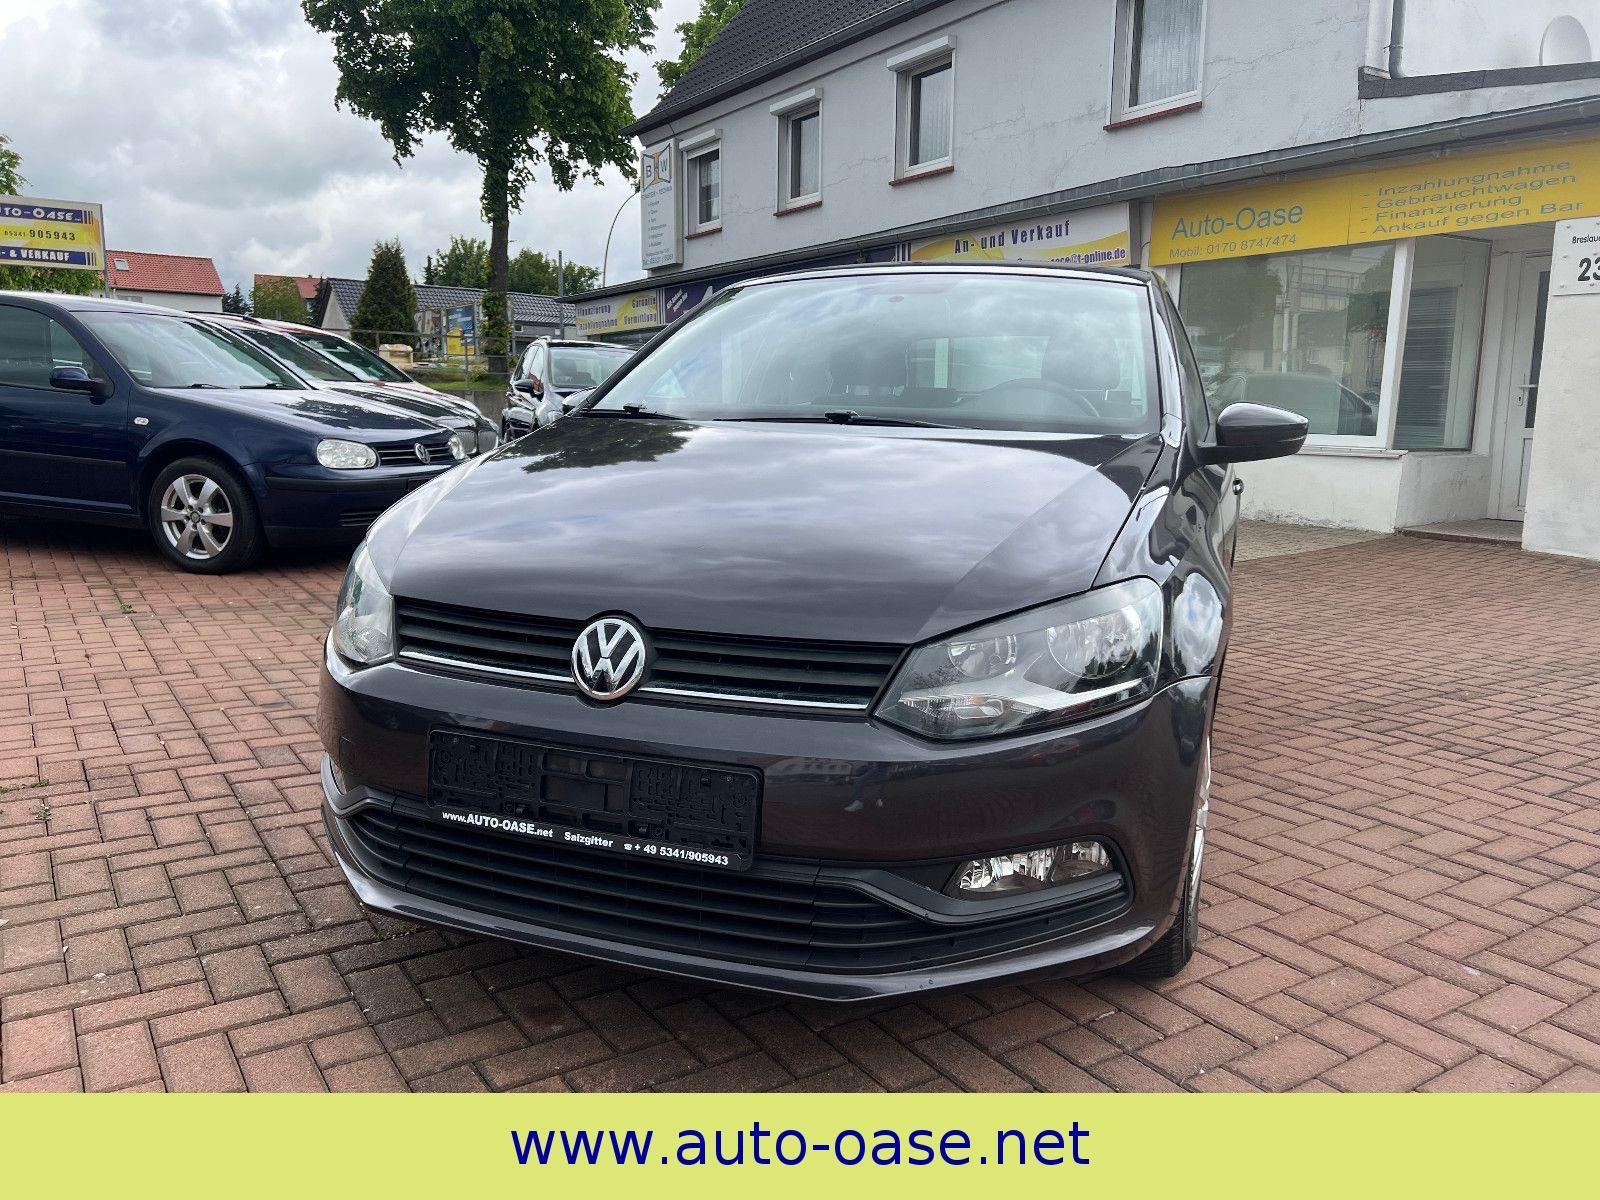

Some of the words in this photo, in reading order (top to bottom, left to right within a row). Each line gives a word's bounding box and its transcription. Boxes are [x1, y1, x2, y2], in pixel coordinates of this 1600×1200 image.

[645, 164, 652, 179] B
[660, 158, 668, 172] W
[1377, 160, 1574, 196] Inzahlungnahme
[1375, 194, 1523, 221] Finanzierung
[1376, 174, 1577, 209] Gebrauchtwagen
[0, 207, 74, 221] TO-OASE
[1171, 205, 1304, 240] Auto-Oase
[1372, 216, 1449, 234] Ankauf
[1456, 208, 1530, 226] gegen
[1540, 201, 1584, 214] Bar
[29, 229, 76, 241] 905943
[954, 239, 975, 254] An-
[981, 231, 1006, 250] und
[1011, 219, 1071, 245] Verkauf
[1169, 247, 1202, 259] Mobil:
[1206, 242, 1237, 254] 0170
[1240, 234, 1297, 250] 8747474
[9, 249, 17, 258] &
[20, 249, 70, 262] VERKAUF
[571, 618, 646, 700] VW
[441, 811, 554, 838] www.AUTO-OASE.net
[564, 831, 614, 848] Salzgitter
[643, 843, 657, 855] 49
[659, 846, 729, 866] 5341/905943
